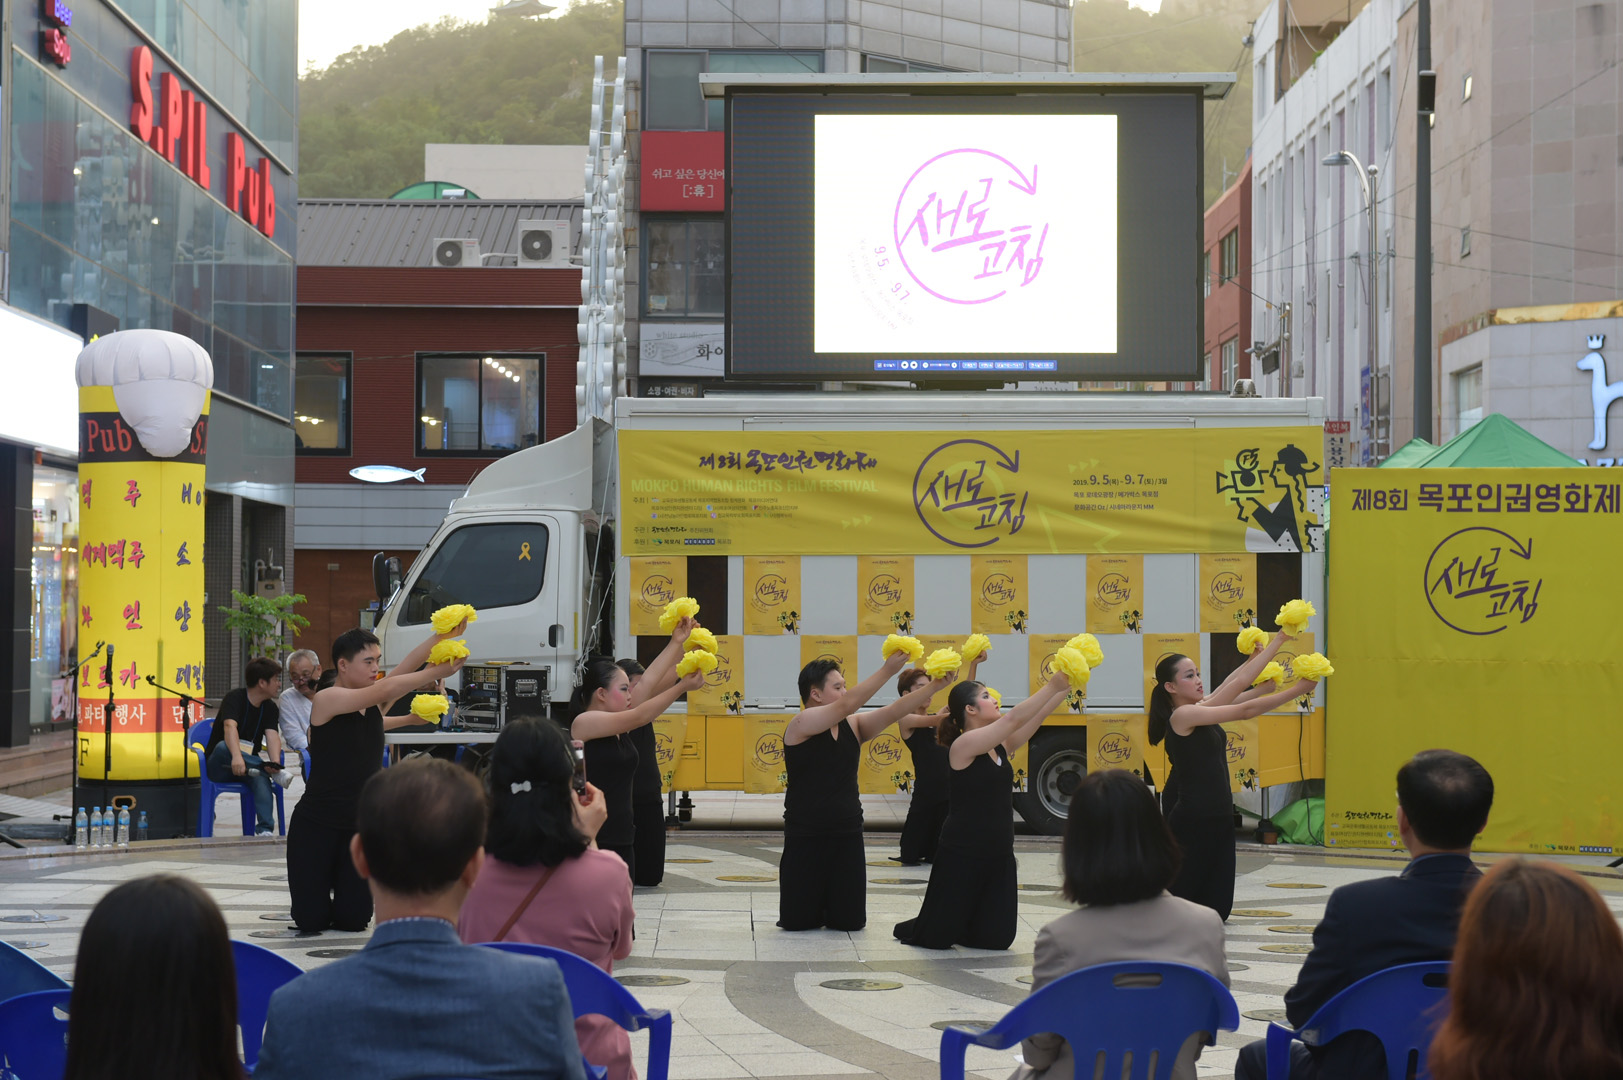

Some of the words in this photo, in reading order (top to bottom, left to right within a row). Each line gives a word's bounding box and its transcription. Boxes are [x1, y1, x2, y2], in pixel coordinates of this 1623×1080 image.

[131, 45, 210, 191] S.PIL
[227, 132, 276, 238] Pub
[652, 168, 673, 180] 쉬고
[675, 168, 695, 180] 싶은
[86, 419, 132, 453] Pub
[699, 451, 742, 470] 제8회
[631, 479, 679, 492] MOKPO
[683, 479, 733, 492] HUMAN
[737, 479, 782, 492] RIGHTS
[787, 479, 816, 492] FILM
[820, 479, 879, 492] FESTIVAL
[1351, 488, 1408, 511] 제8회
[1417, 482, 1621, 513] 목포인권영화제
[115, 703, 147, 726] 행사
